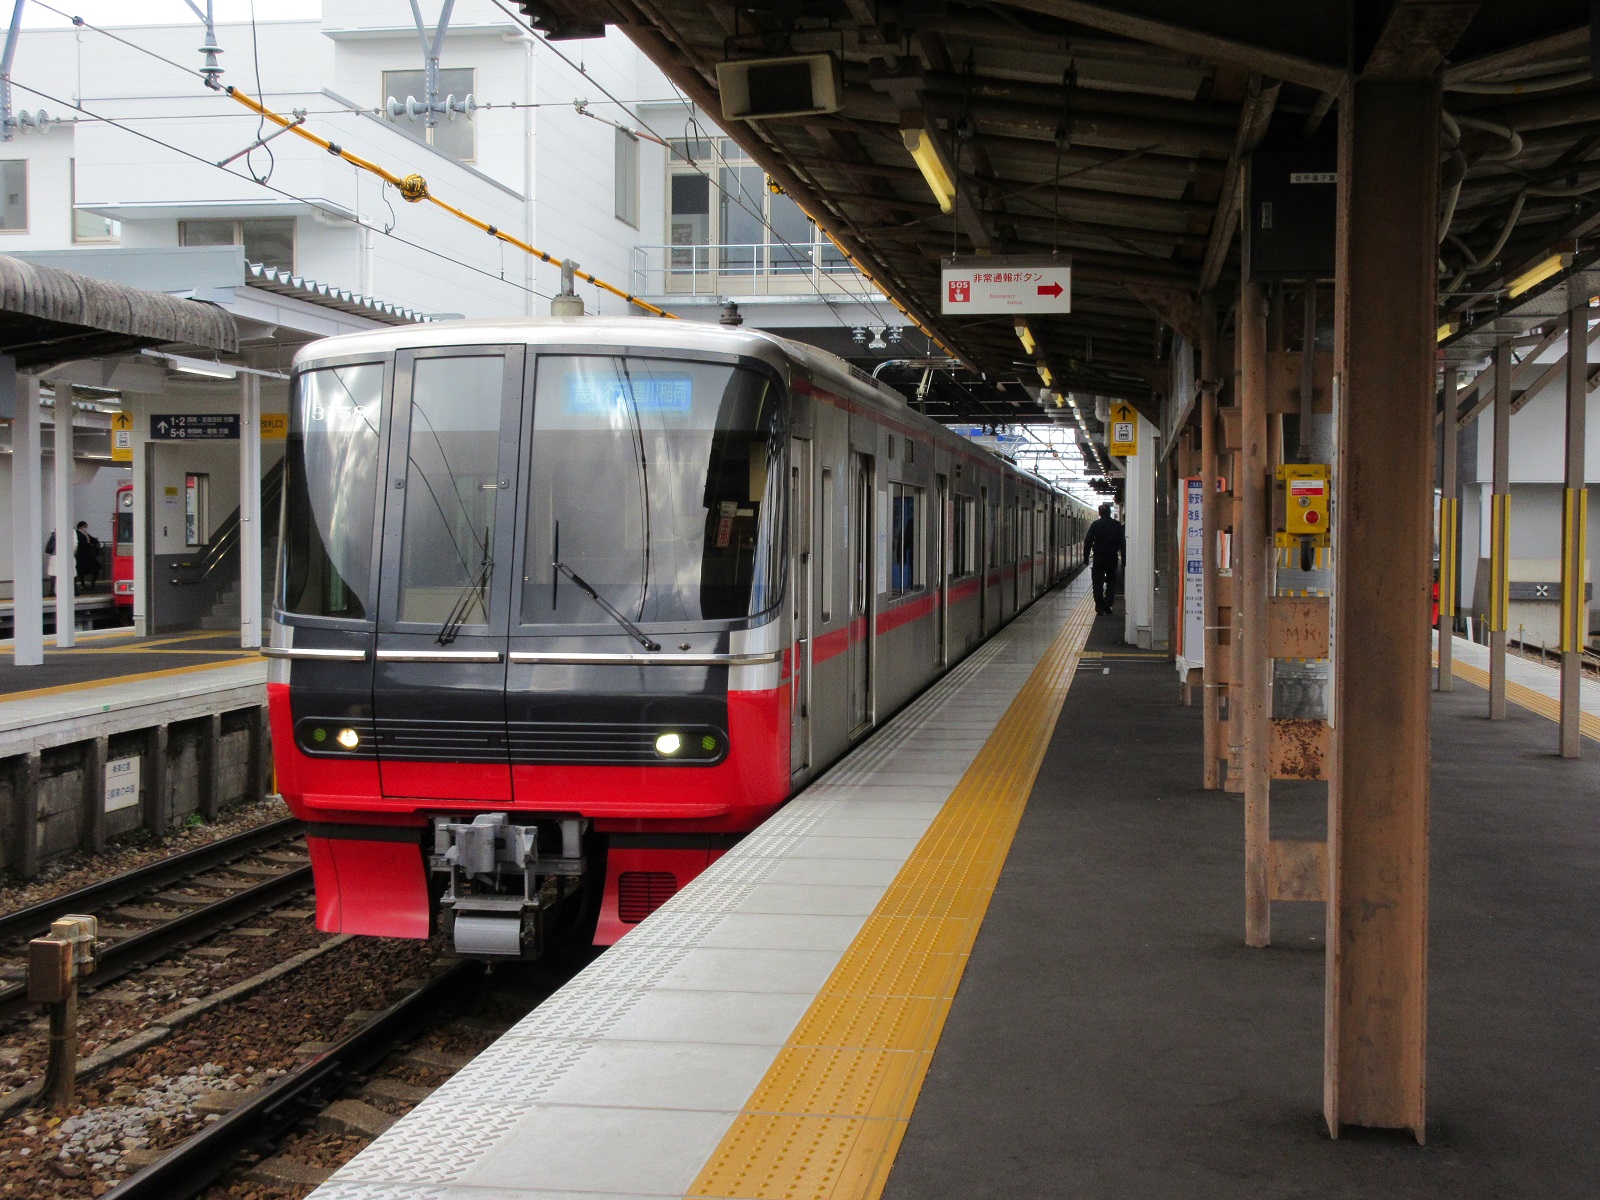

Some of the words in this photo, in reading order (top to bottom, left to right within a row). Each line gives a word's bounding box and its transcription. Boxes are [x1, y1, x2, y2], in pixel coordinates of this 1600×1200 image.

[973, 272, 1043, 283] 非常通報ボタン
[950, 281, 968, 289] SOS
[632, 381, 687, 403] 豊川稲荷
[1188, 510, 1203, 521] 改良
